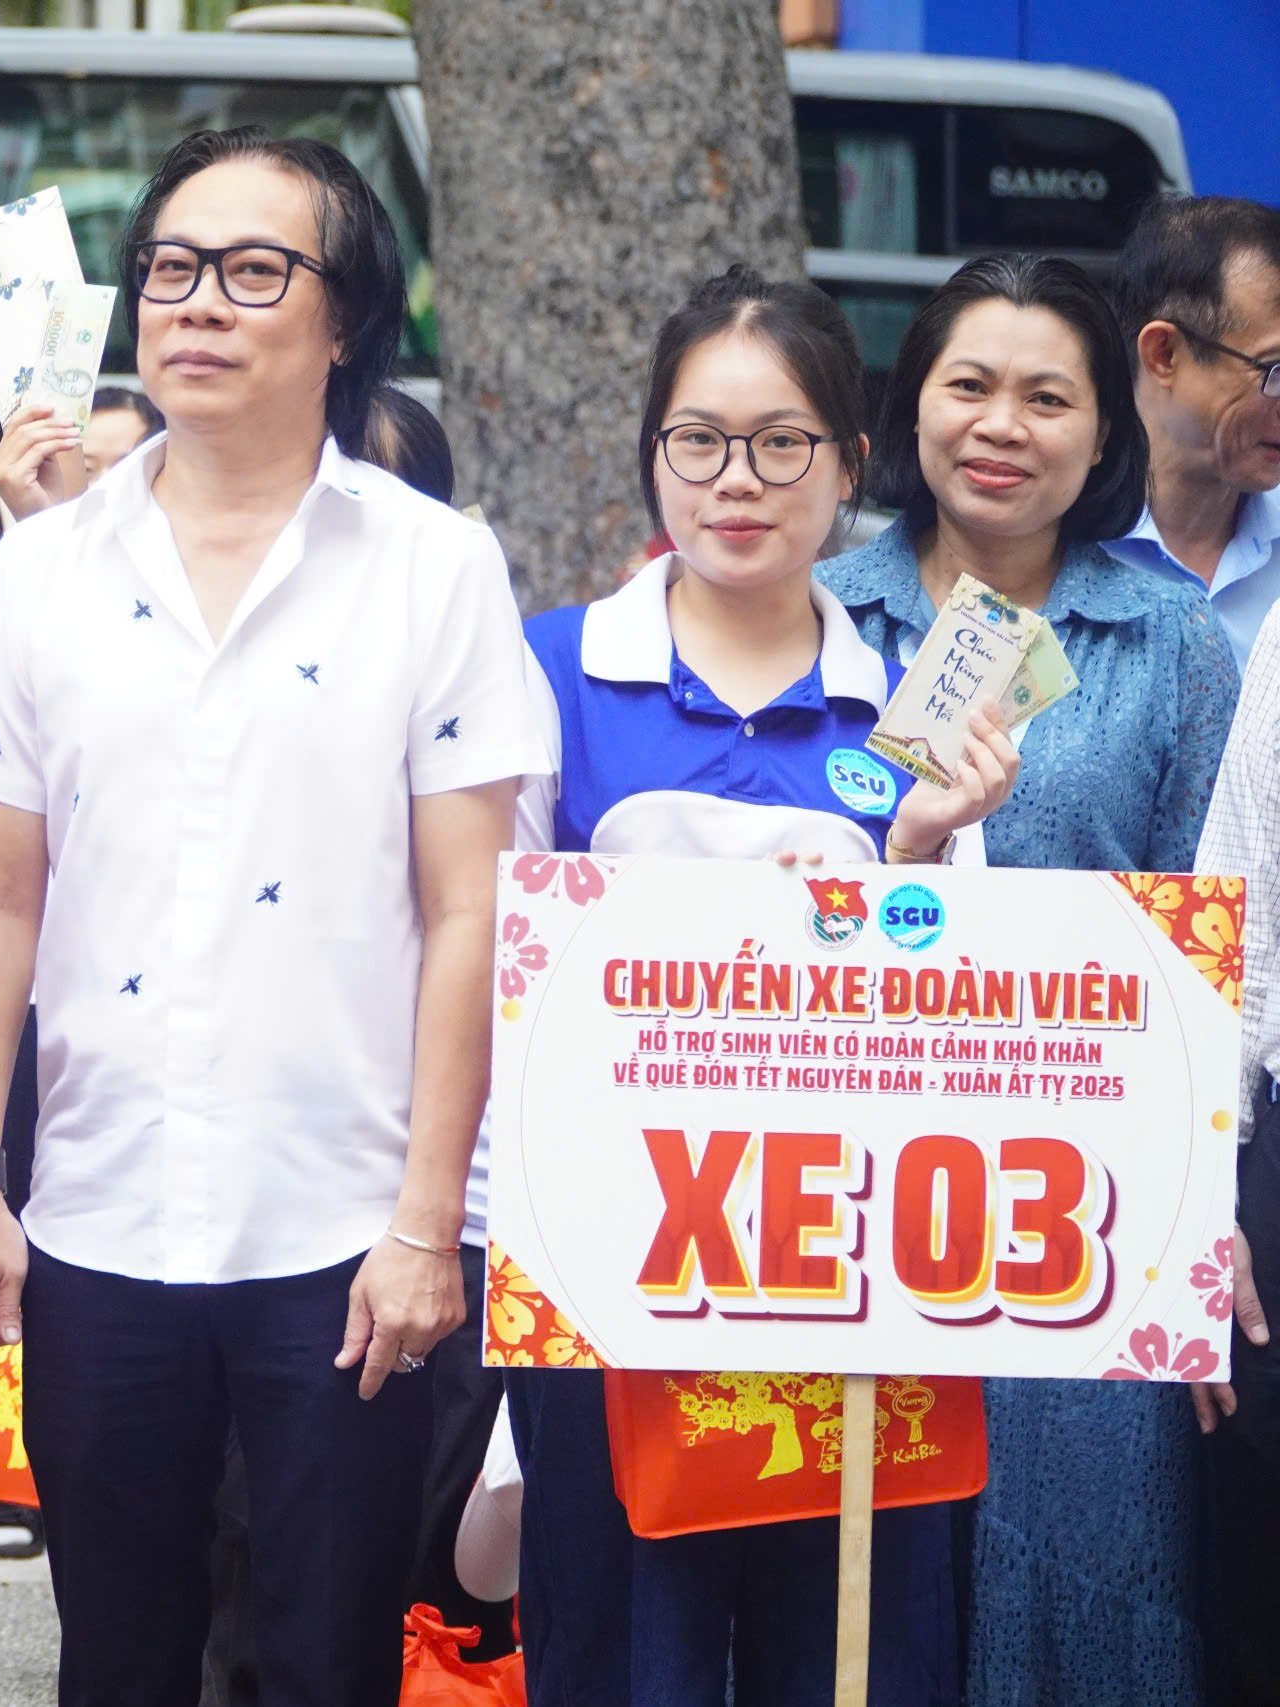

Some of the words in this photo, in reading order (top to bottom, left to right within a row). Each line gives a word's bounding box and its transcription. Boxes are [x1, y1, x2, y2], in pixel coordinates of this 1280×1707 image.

[834, 764, 886, 796] SGU
[886, 906, 939, 926] SGU
[604, 938, 795, 1016] CHUYẾN
[805, 965, 871, 1018] XE
[880, 956, 1018, 1022] ĐOÀN
[1029, 961, 1143, 1027] VIÊN
[638, 1020, 668, 1052] HỖ
[673, 1029, 718, 1060] TRỢ
[722, 1031, 773, 1055] SINH
[778, 1029, 827, 1057] VIÊN
[833, 1031, 860, 1058] CÓ
[865, 1032, 925, 1059] HOÀN
[931, 1032, 987, 1061] CẢNH
[993, 1035, 1038, 1063] KHÓ
[1043, 1037, 1103, 1065] KHĂN
[614, 1052, 639, 1085] VỀ
[646, 1058, 688, 1088] QUÊ
[693, 1059, 738, 1086] ĐÓN
[744, 1057, 782, 1088] TẾT
[787, 1063, 872, 1090] NGUYÊN
[879, 1065, 923, 1092] ĐÁN
[943, 1067, 1002, 1094] XUÂN
[1008, 1063, 1035, 1095] ẤT
[1040, 1074, 1067, 1103] TỴ
[1070, 1075, 1125, 1098] 2025
[635, 1128, 854, 1304] XE
[892, 1134, 1102, 1308] 03
